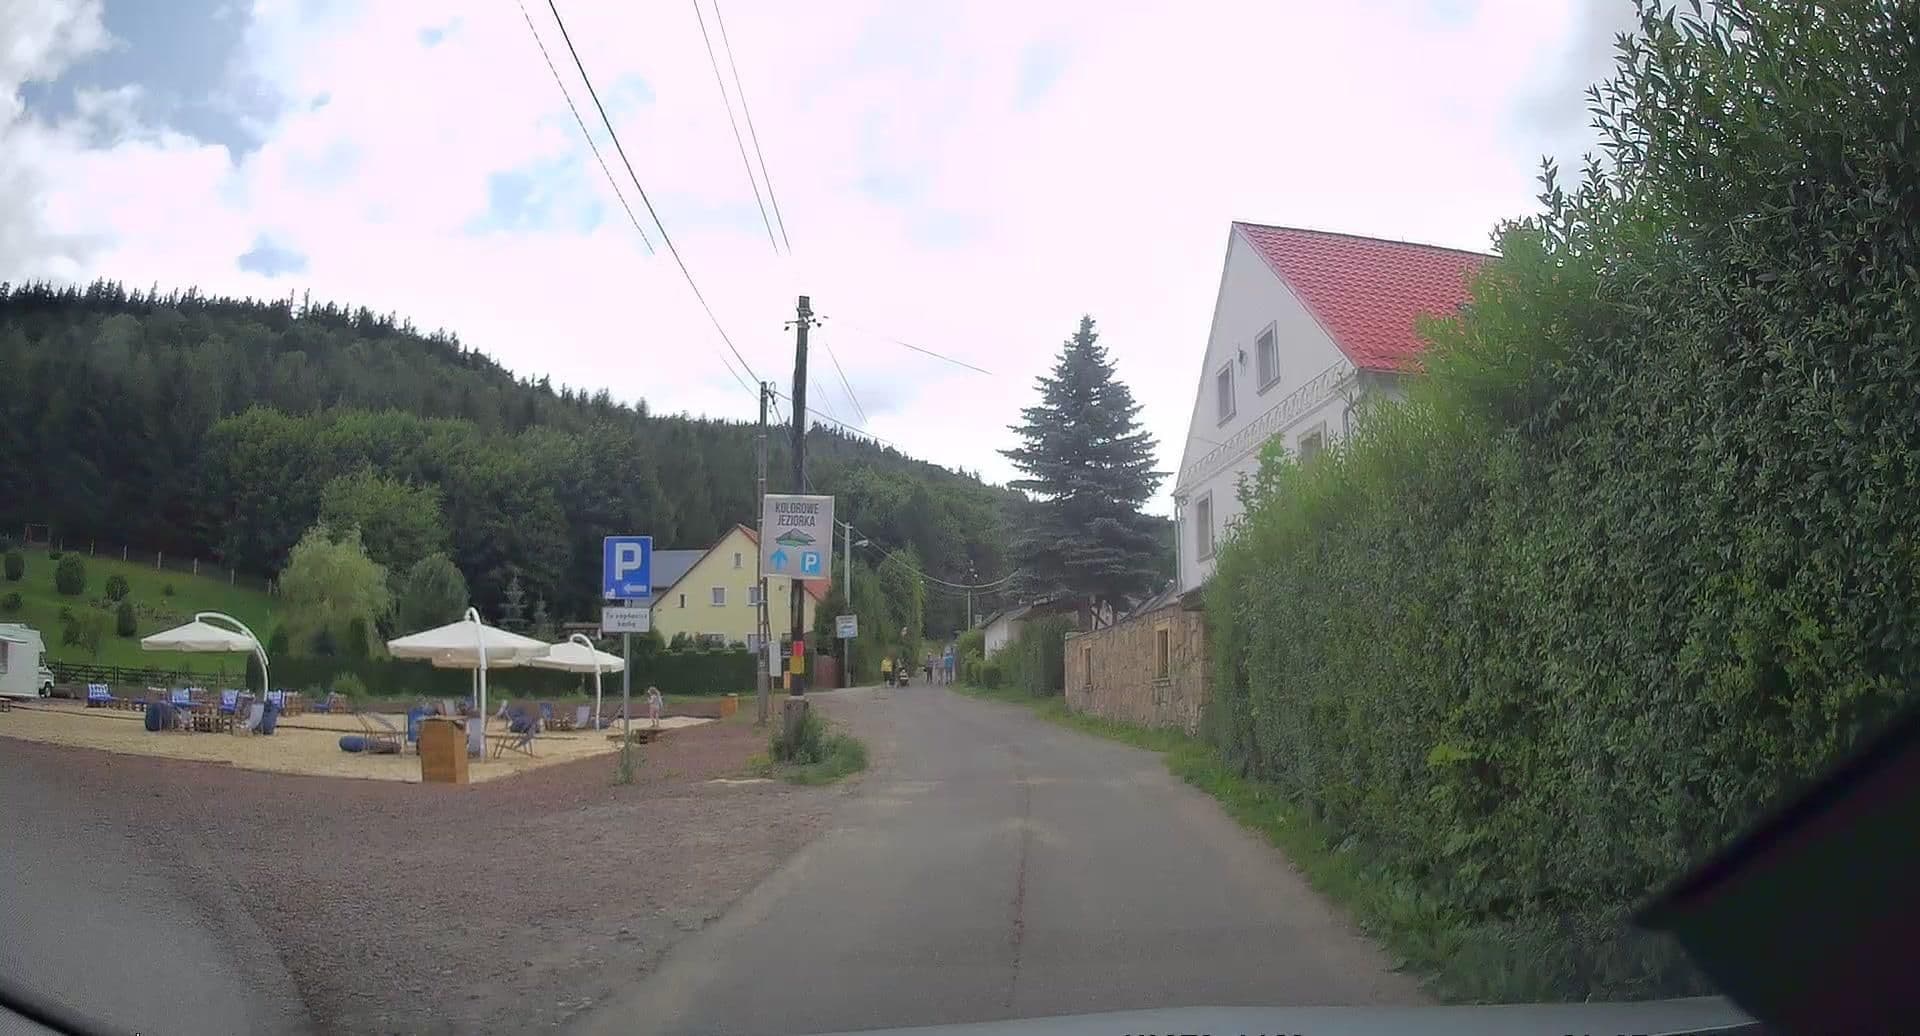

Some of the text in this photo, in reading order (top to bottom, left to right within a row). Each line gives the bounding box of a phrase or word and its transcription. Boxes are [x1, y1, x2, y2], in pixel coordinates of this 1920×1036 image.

[775, 502, 819, 514] KOLOROWE
[777, 514, 816, 527] JEZIORKA
[615, 542, 642, 581] P
[805, 553, 817, 571] P
